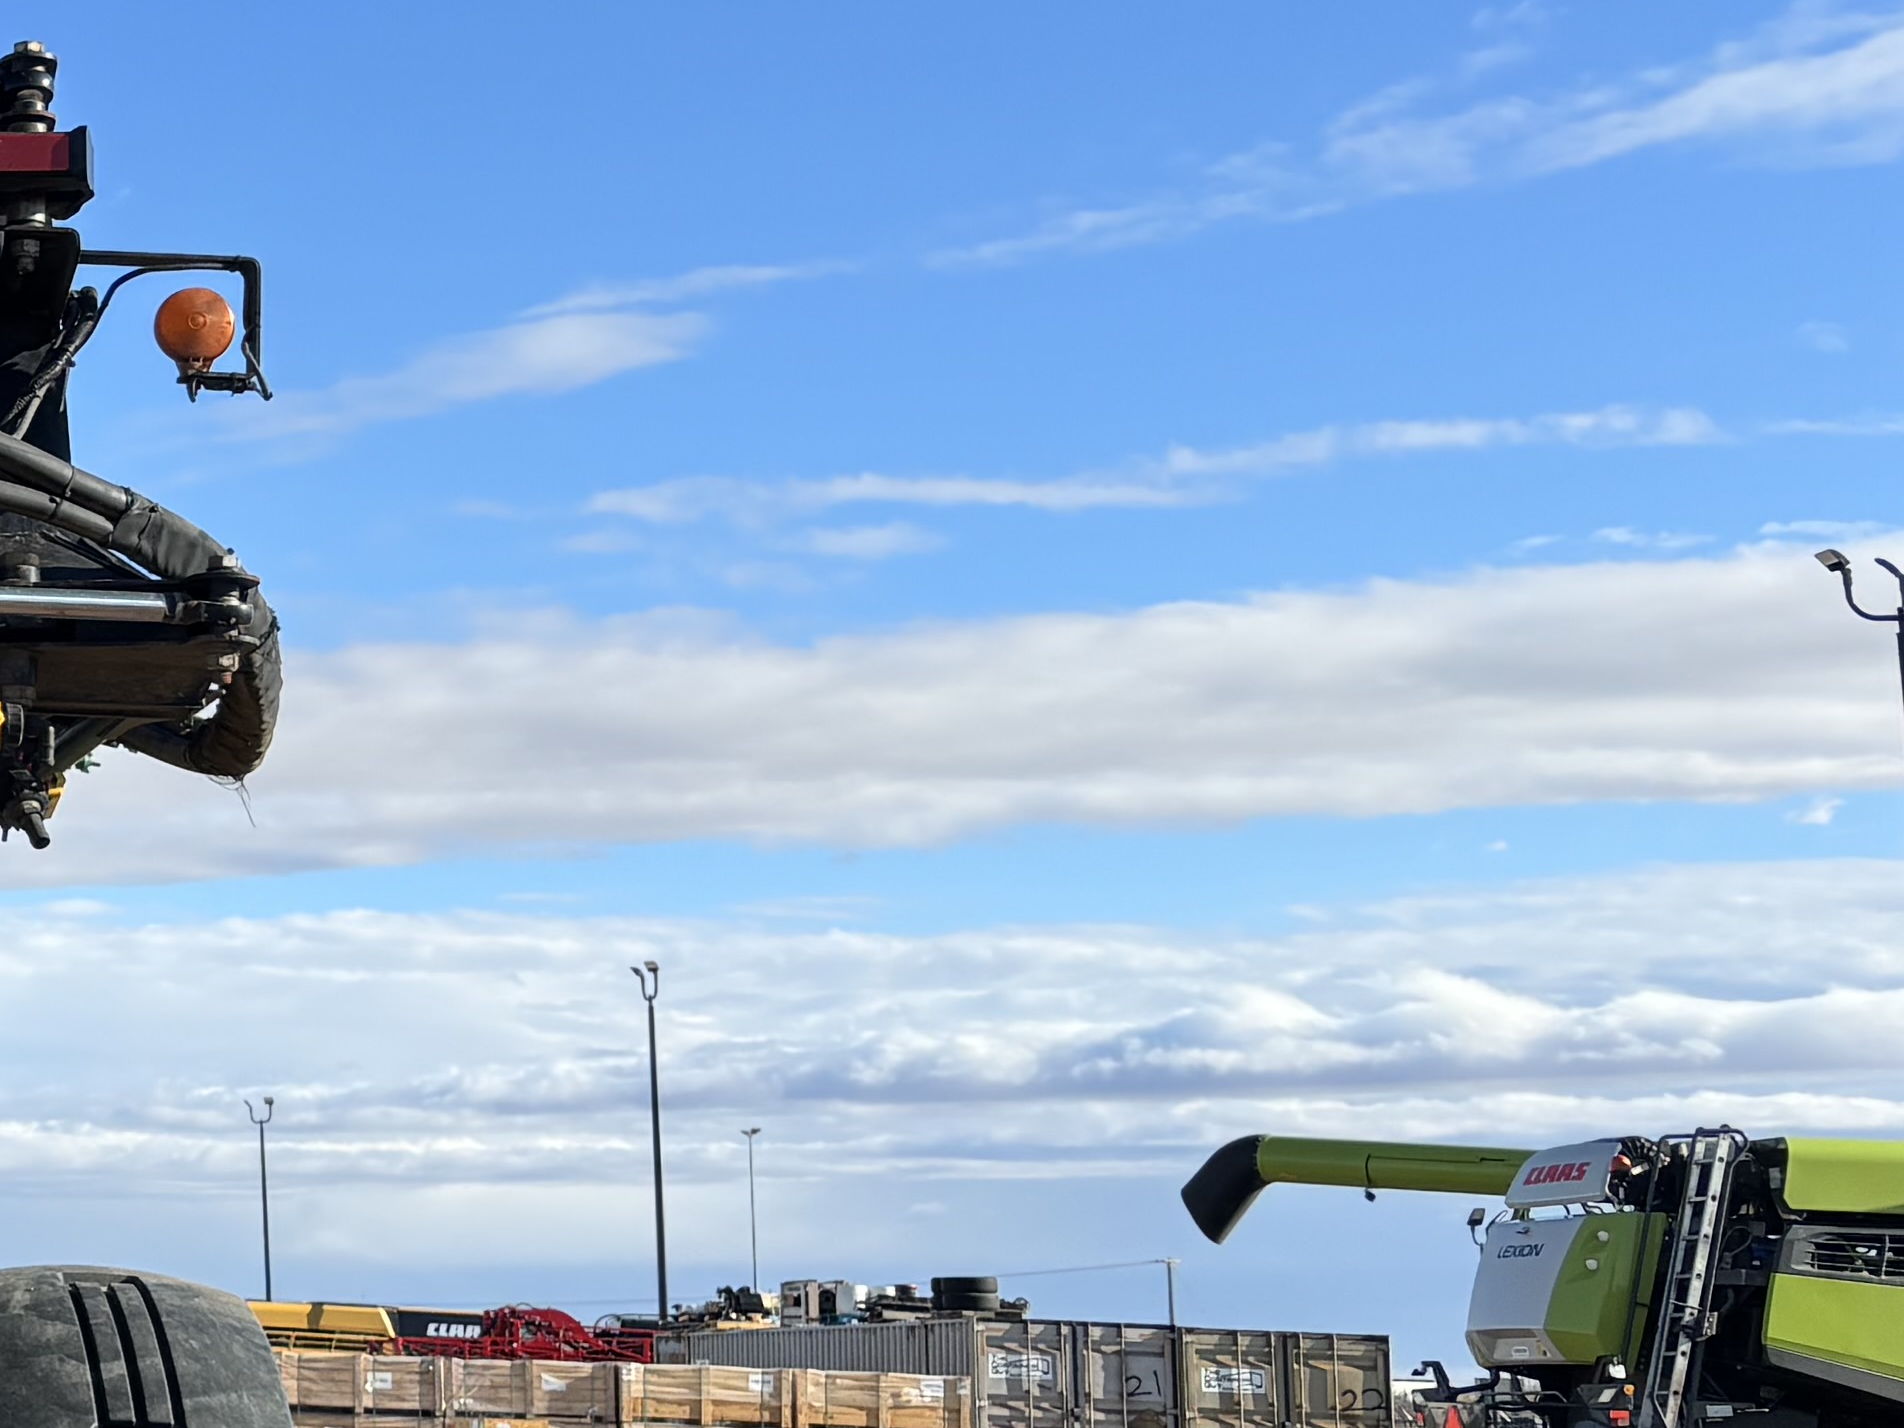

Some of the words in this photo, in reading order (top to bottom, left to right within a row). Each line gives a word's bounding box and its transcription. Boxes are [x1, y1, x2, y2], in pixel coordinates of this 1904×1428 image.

[1523, 1162, 1591, 1186] CLAAS
[1497, 1243, 1545, 1259] LEXION
[426, 1322, 482, 1339] CLAA
[1125, 1370, 1162, 1397] 21
[1337, 1388, 1387, 1411] 22
